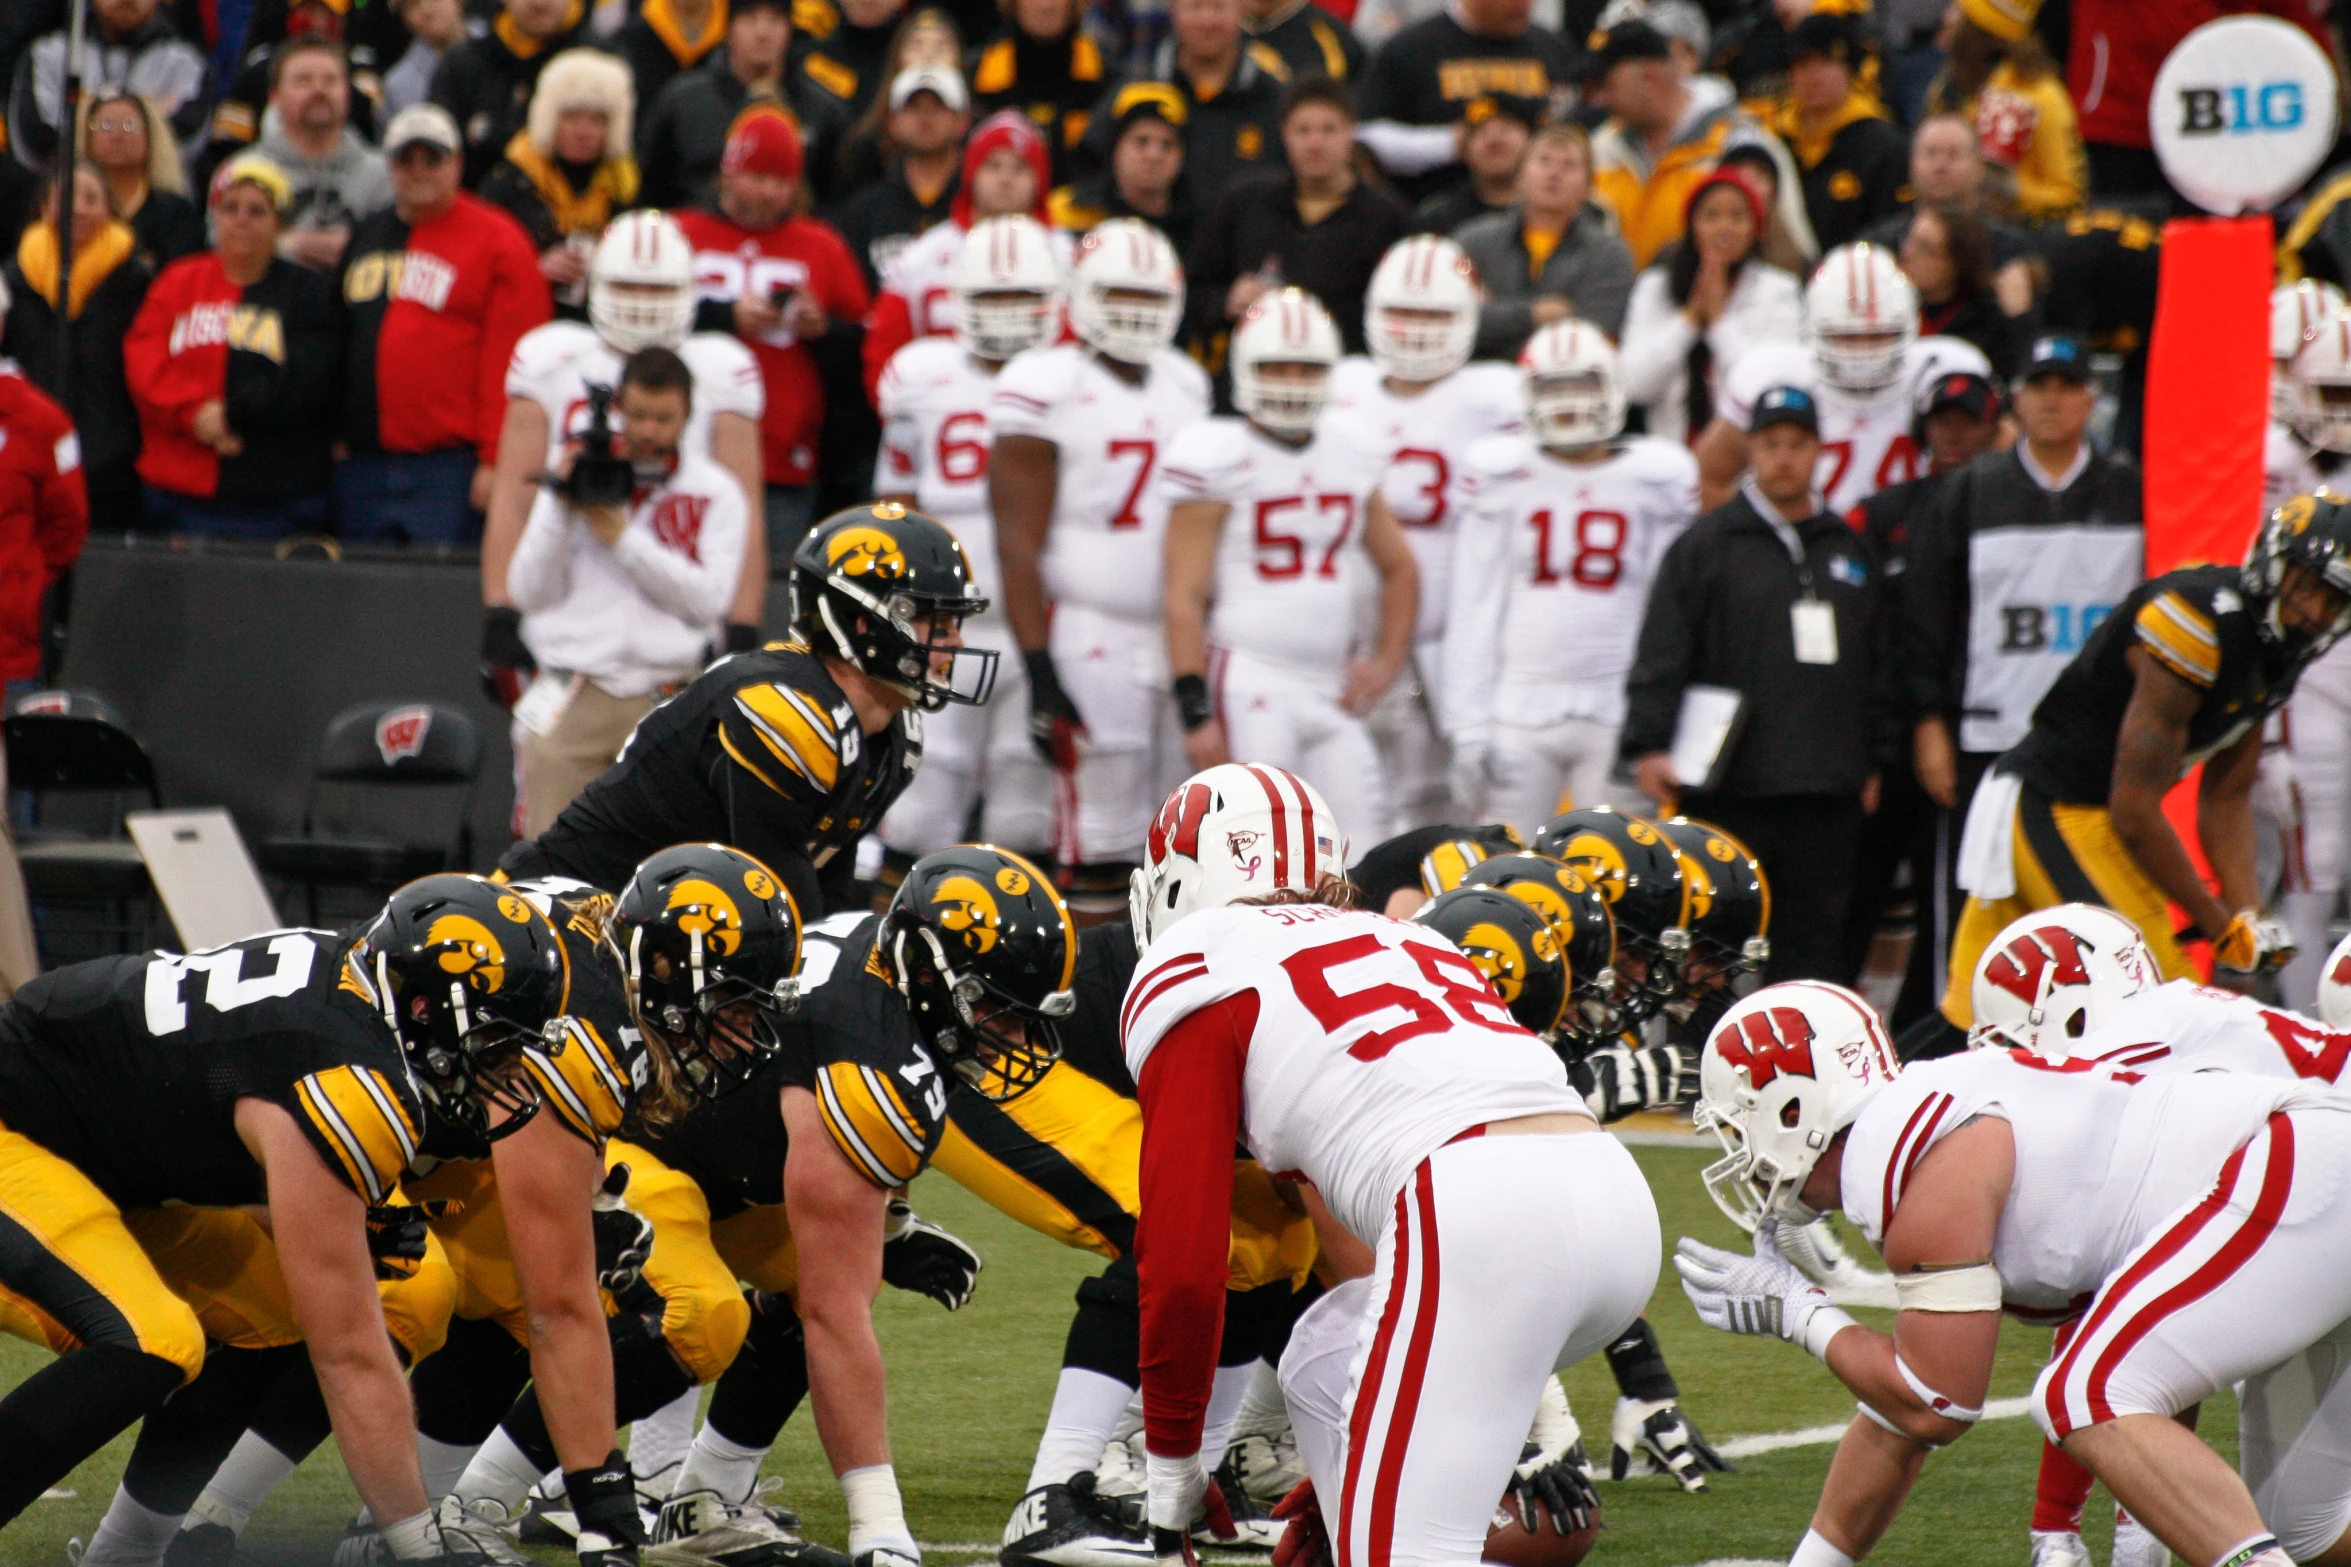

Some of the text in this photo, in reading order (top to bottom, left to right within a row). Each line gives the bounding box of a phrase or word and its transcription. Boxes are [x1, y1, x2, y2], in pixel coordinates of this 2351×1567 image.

[1105, 439, 1156, 530] 7
[1255, 493, 1355, 580] 57
[1529, 508, 1628, 591] 18
[1279, 933, 1538, 1063] 58
[1714, 1007, 1817, 1092] W
